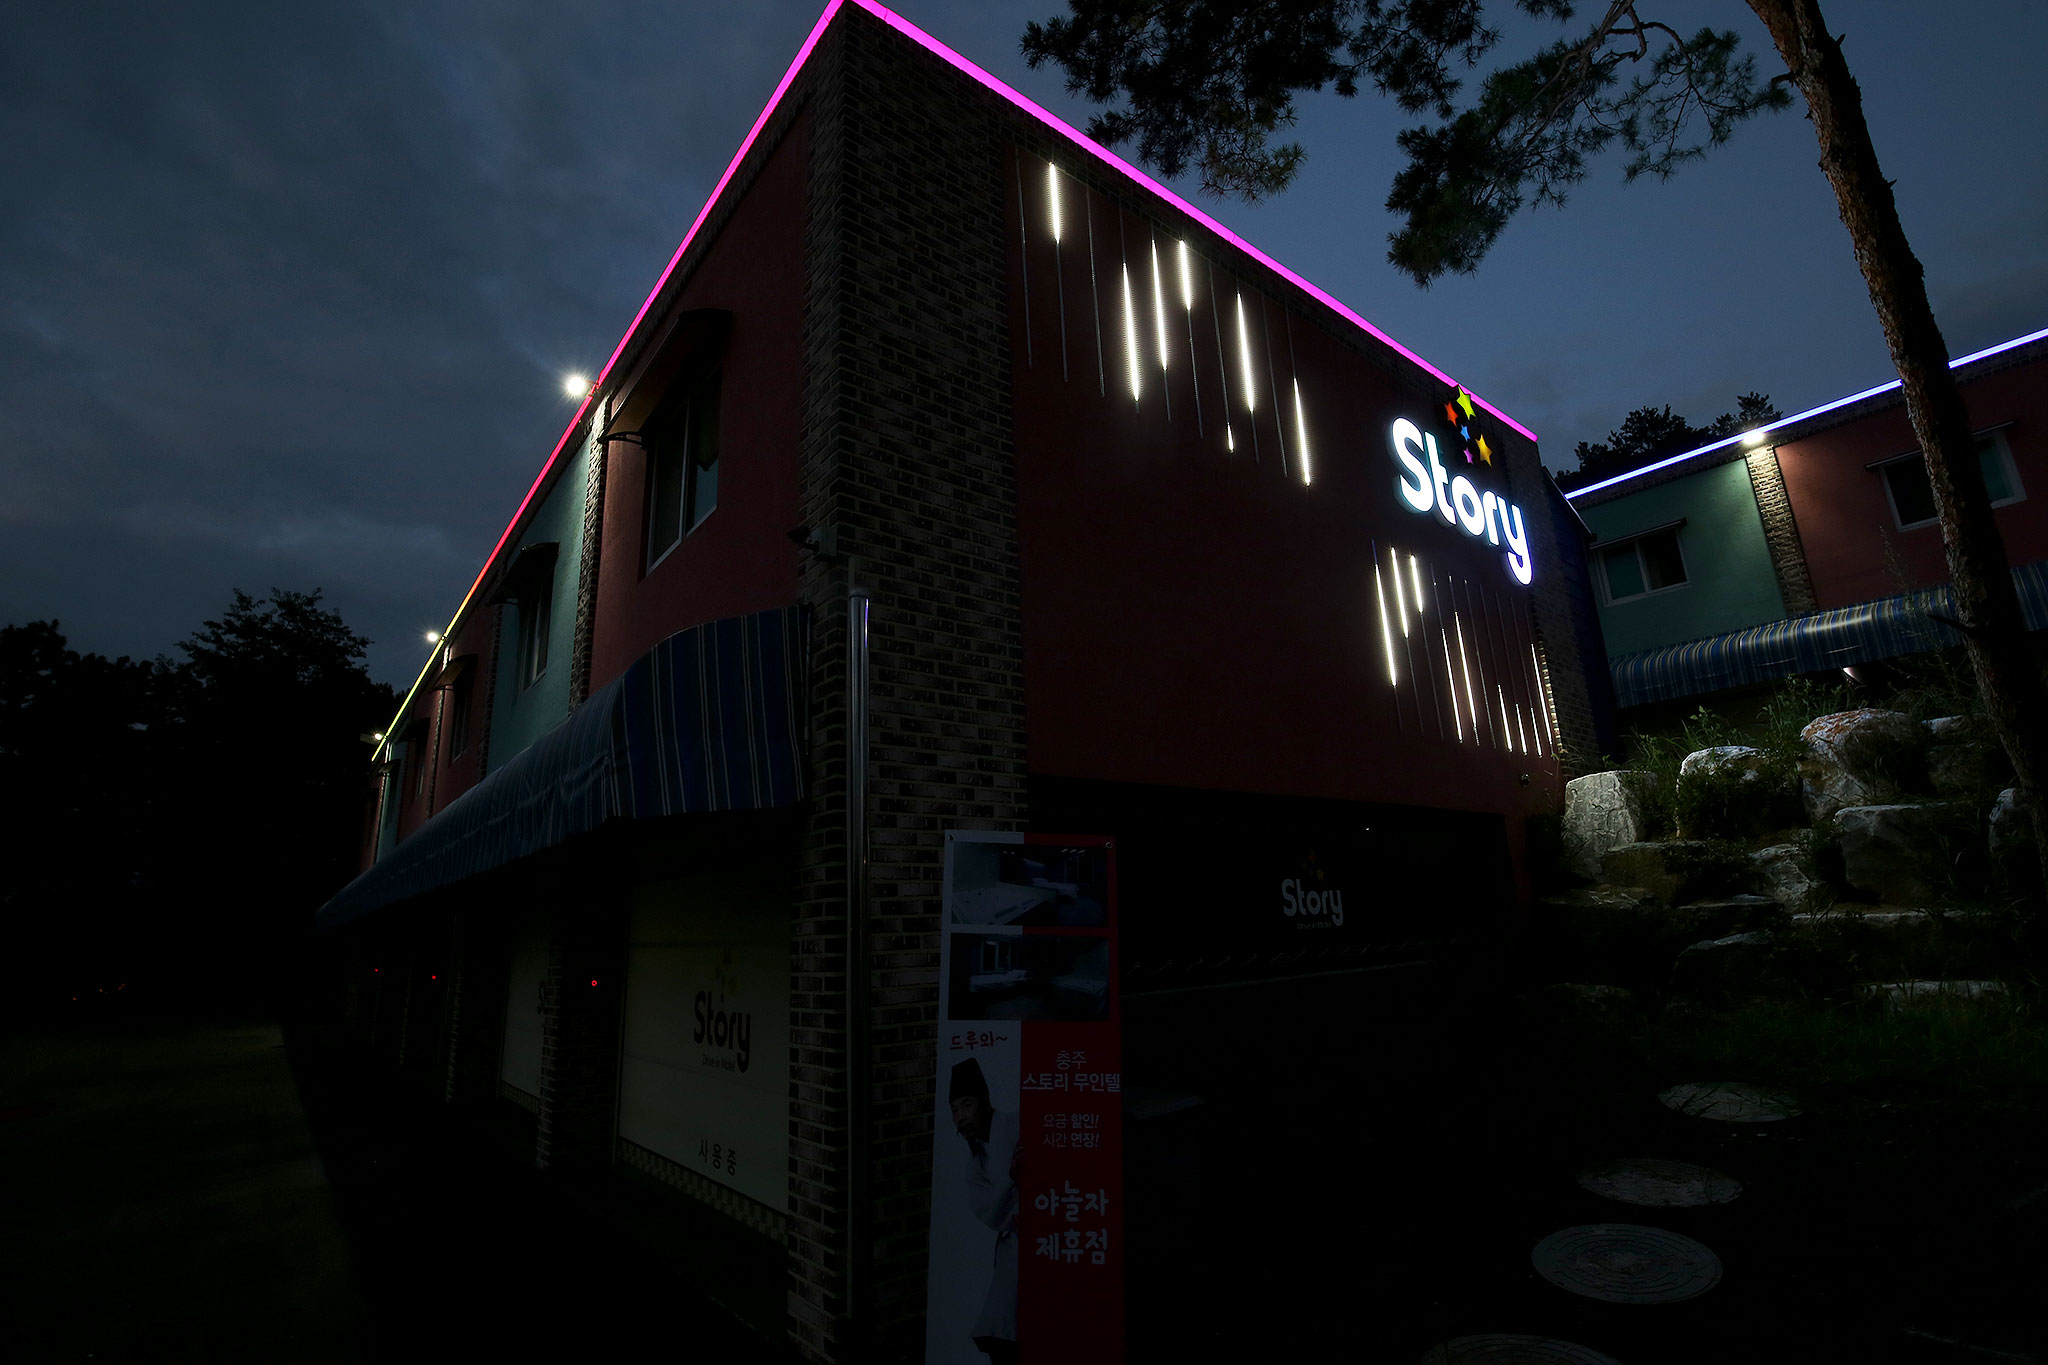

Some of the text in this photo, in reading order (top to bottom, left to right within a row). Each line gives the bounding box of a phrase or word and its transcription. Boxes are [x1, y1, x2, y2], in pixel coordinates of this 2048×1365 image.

[1392, 417, 1534, 585] Story
[1281, 878, 1344, 927] Story
[694, 990, 750, 1073] Story
[950, 1031, 1008, 1050] 드루와~
[1056, 1051, 1088, 1070] 충주
[1021, 1073, 1121, 1093] 스토리 무인텔
[1043, 1113, 1099, 1129] 요금 할인!
[1042, 1133, 1100, 1148] 시간 연장!
[1034, 1179, 1110, 1222] 야놀자
[1035, 1227, 1108, 1264] 제휴점
